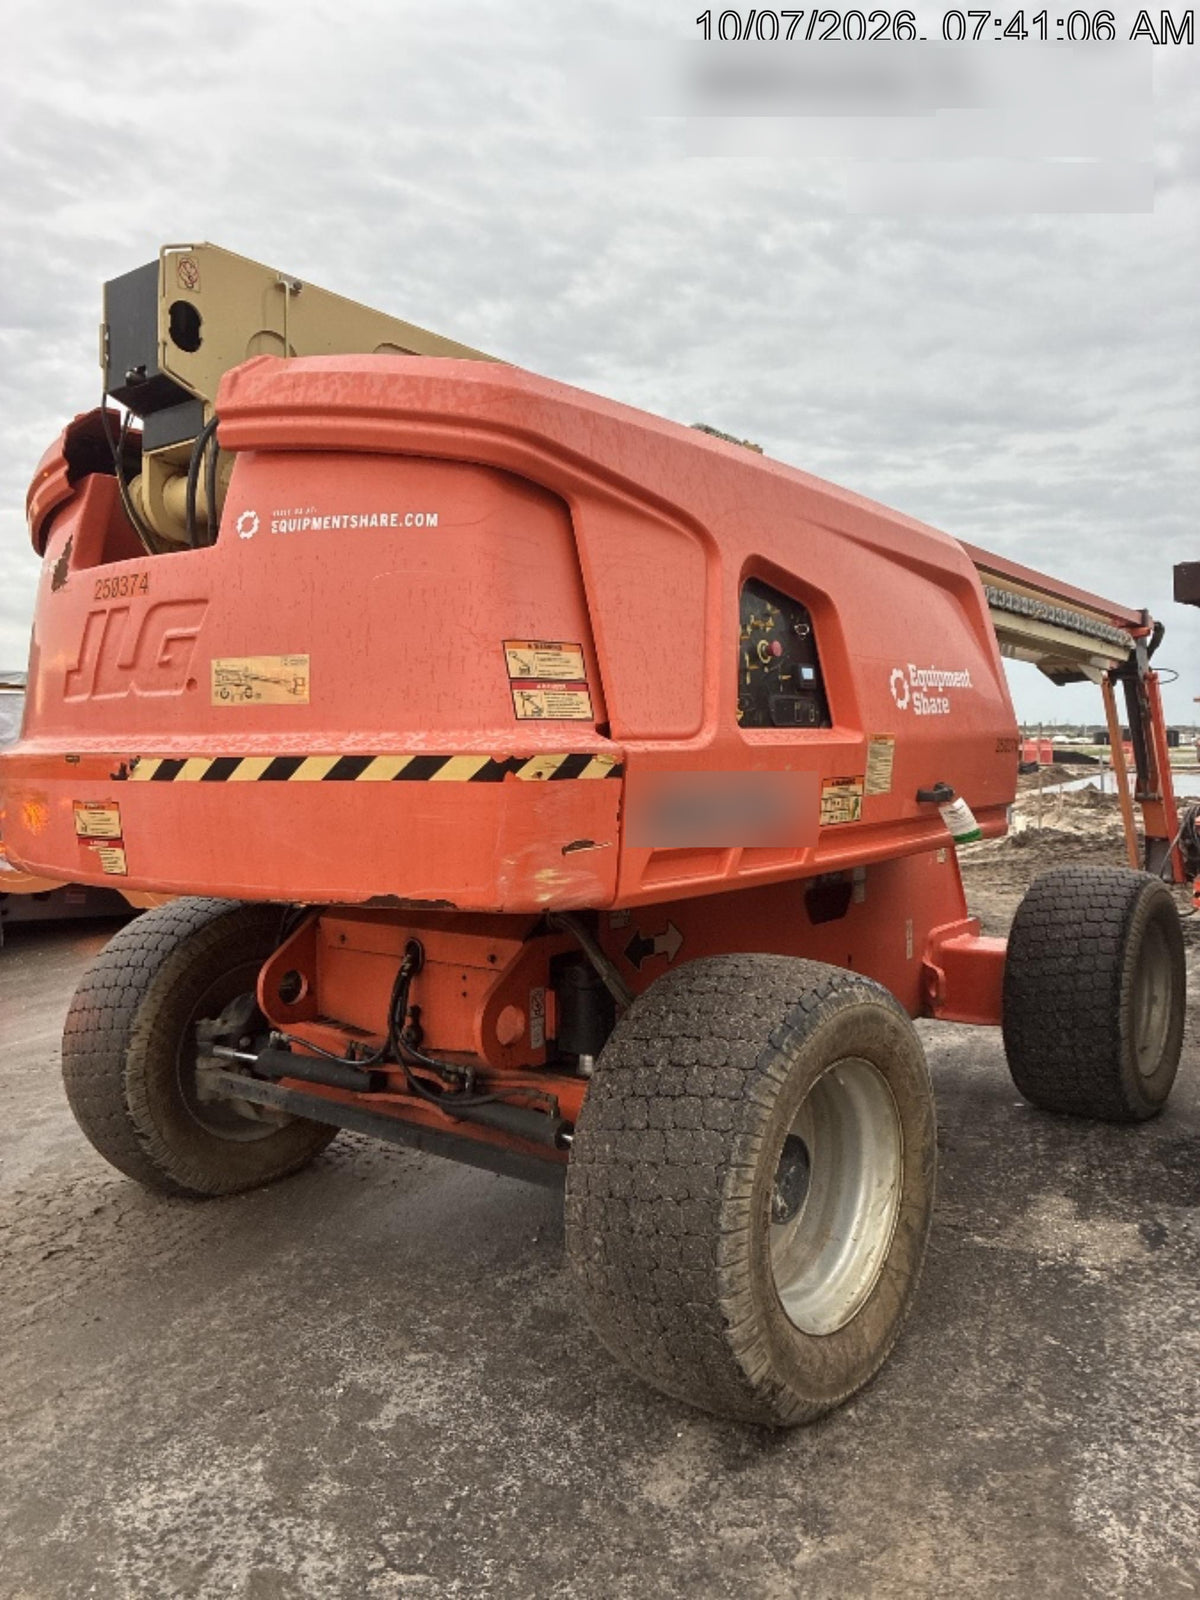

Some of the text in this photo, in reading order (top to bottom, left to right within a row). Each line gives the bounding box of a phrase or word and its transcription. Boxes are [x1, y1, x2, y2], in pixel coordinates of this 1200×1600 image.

[271, 512, 439, 534] EQUIPMENTSHARE.COM
[94, 571, 149, 600] 250374
[63, 598, 209, 703] JLG
[907, 663, 974, 693] Equipment
[912, 691, 951, 716] Share
